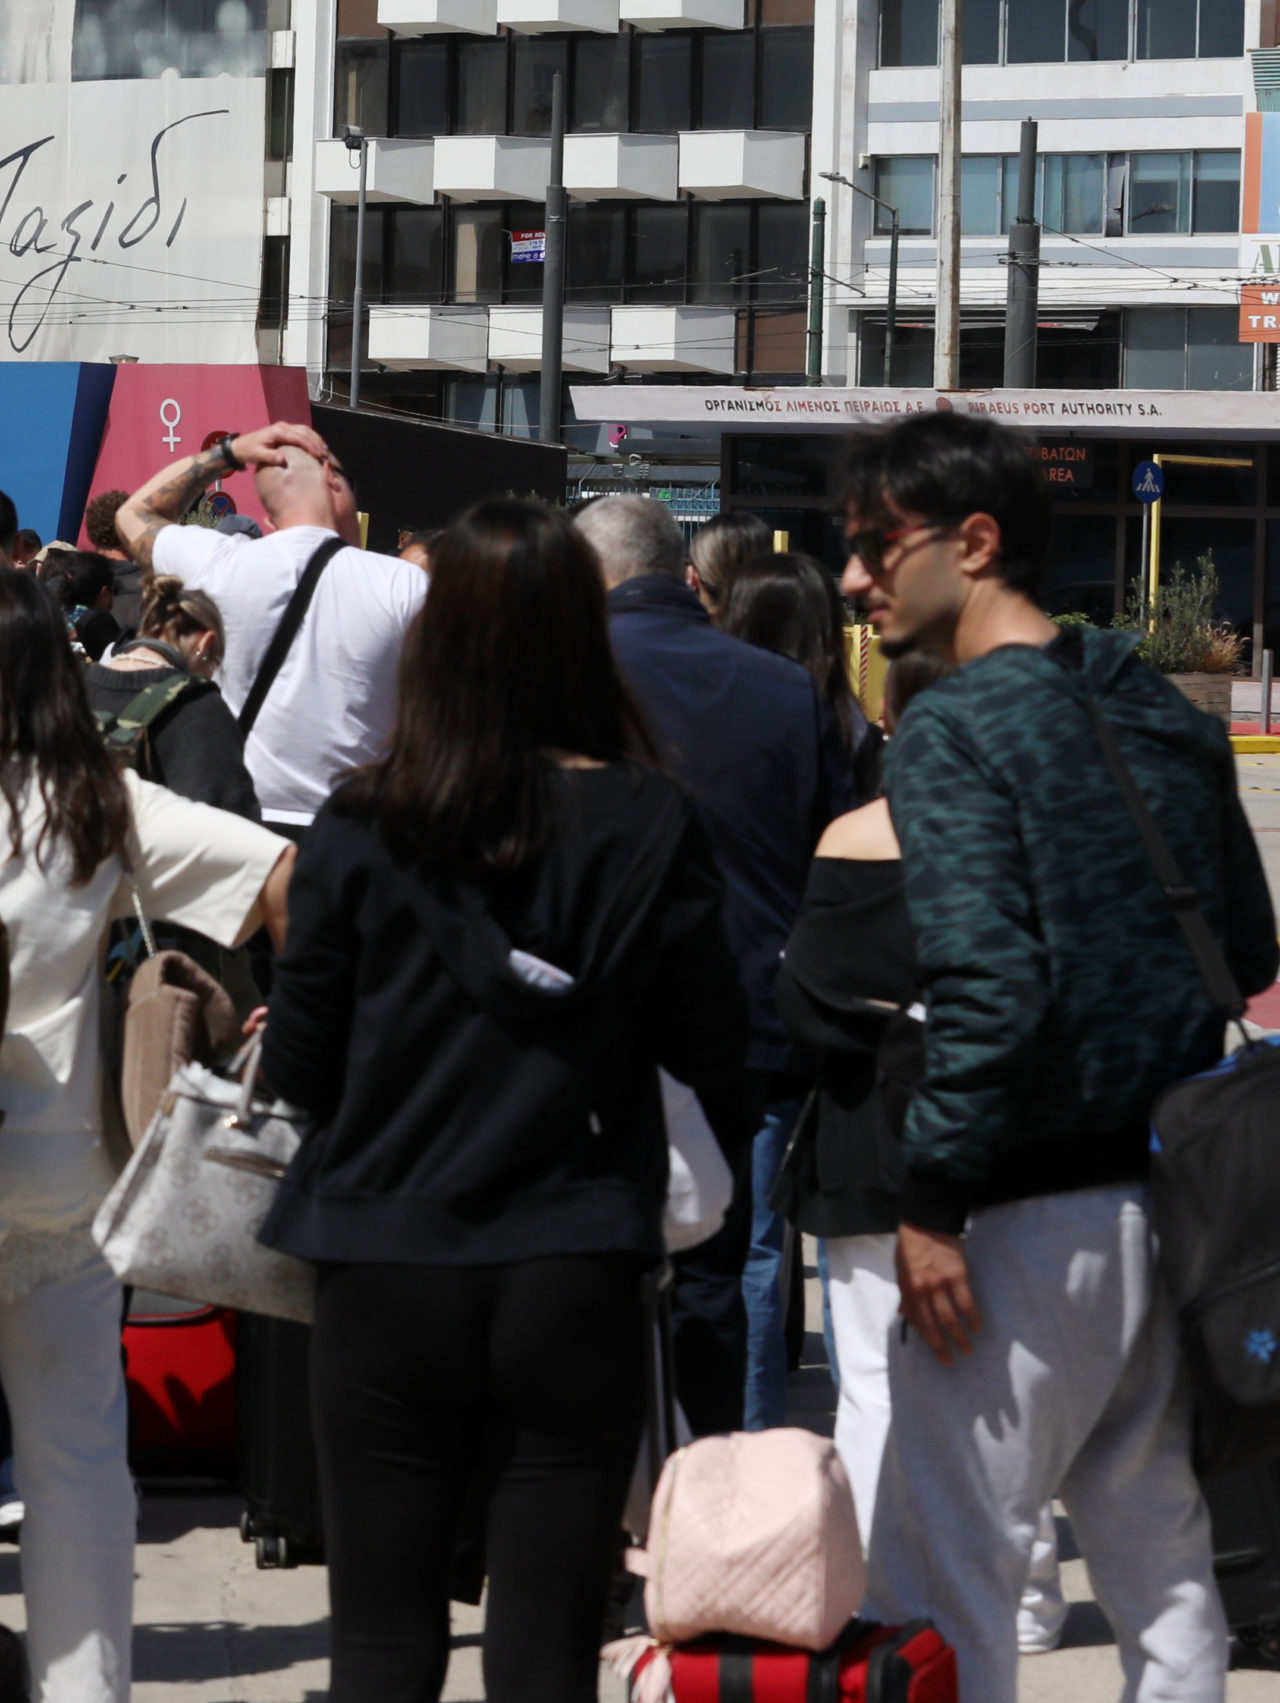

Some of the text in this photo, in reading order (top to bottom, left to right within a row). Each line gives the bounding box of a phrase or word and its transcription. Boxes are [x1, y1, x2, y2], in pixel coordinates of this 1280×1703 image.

[1250, 244, 1280, 274] A
[1247, 315, 1280, 329] TR
[705, 399, 783, 412] ΟΡΓΑΝΙΣΜΟΣ
[786, 400, 840, 413] ΛΙΜΕΝΟΣ
[843, 400, 901, 413] ΠΕΙΡΑΙΩΣ
[968, 401, 1163, 416] PIRAEUS PORT AUTHORITY S.A.
